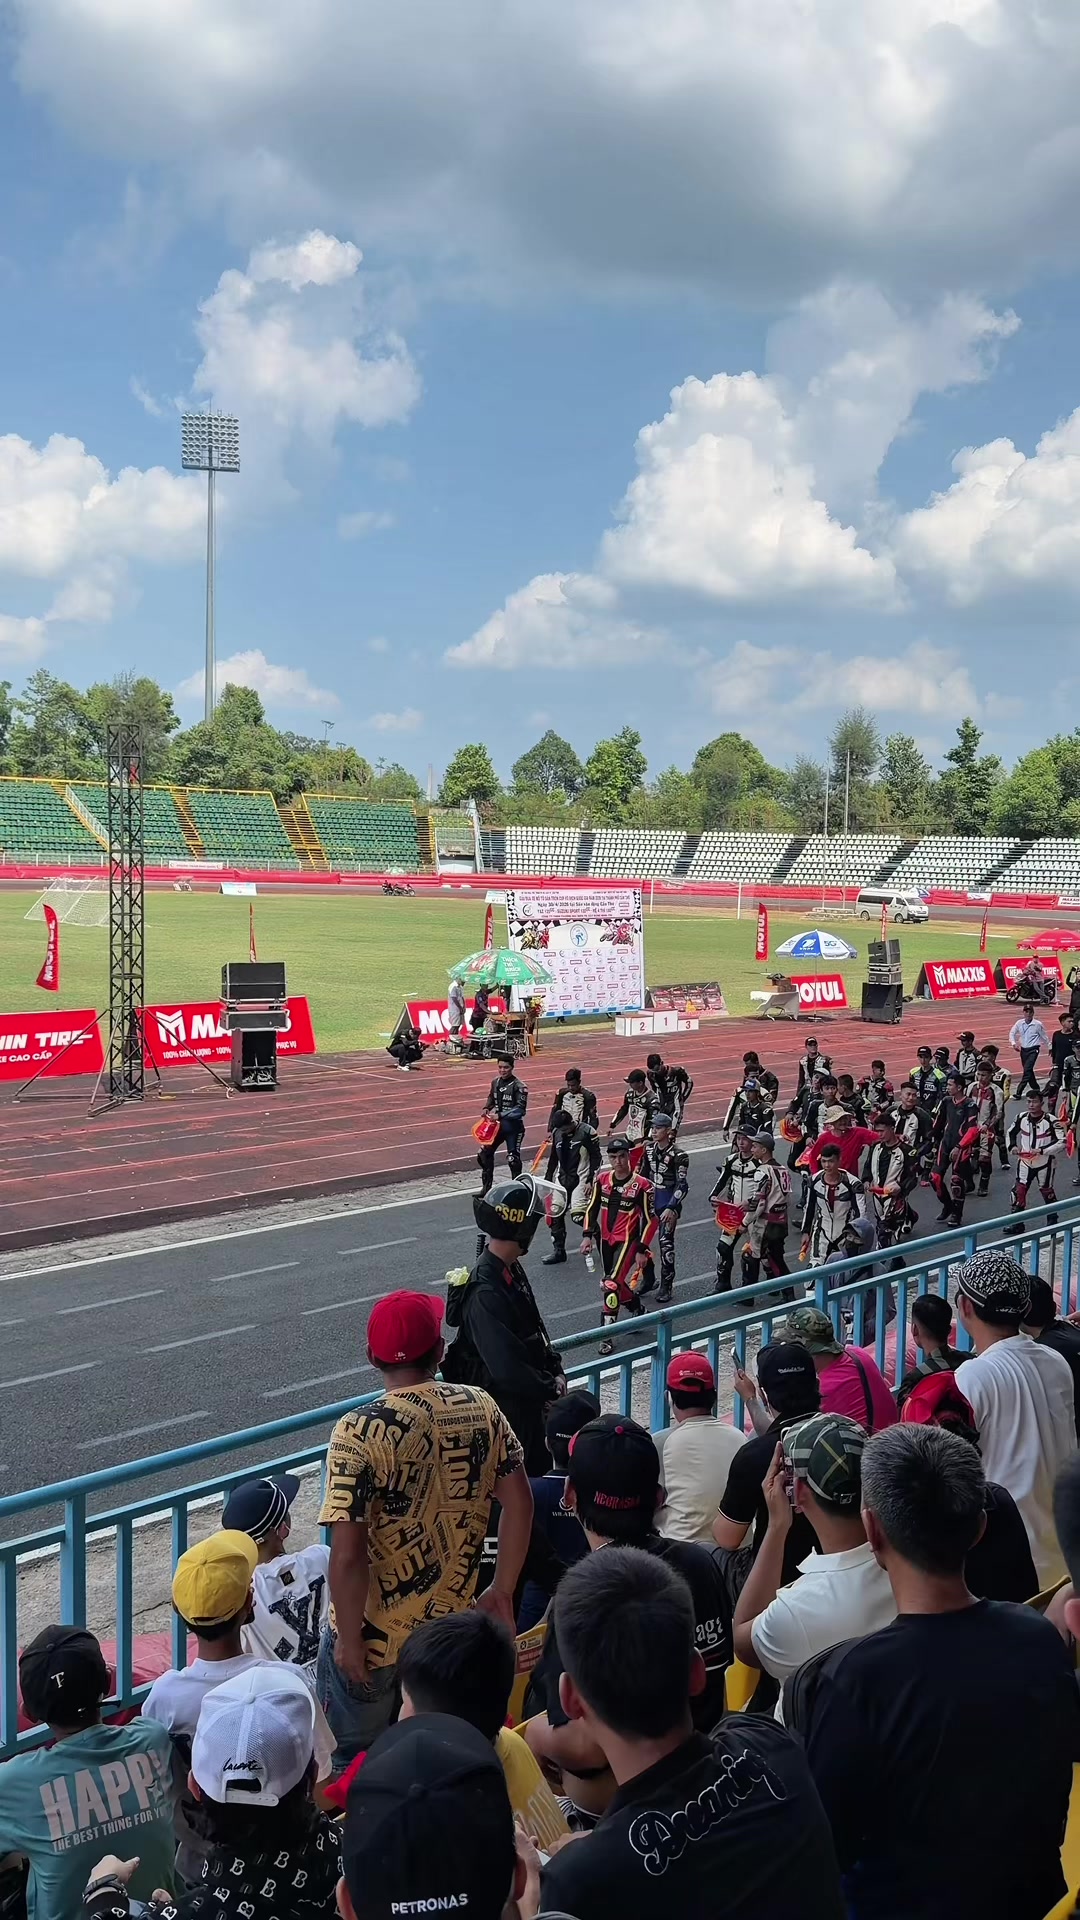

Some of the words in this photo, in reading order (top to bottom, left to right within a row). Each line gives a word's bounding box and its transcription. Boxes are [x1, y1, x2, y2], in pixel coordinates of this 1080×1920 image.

[757, 912, 765, 952] MOTUL
[947, 966, 986, 983] MAXXIS
[640, 1022, 645, 1031] 2
[664, 1017, 668, 1026] 1
[685, 1021, 690, 1029] 3
[9, 1053, 30, 1062] CAO
[32, 1050, 52, 1060] CẤP
[163, 1051, 178, 1059] 100%
[52, 1835, 71, 1852] THE
[73, 1826, 98, 1846] BEST
[102, 1816, 132, 1836] THING
[134, 1809, 153, 1825] FOR
[391, 1893, 469, 1914] PETRONAS
